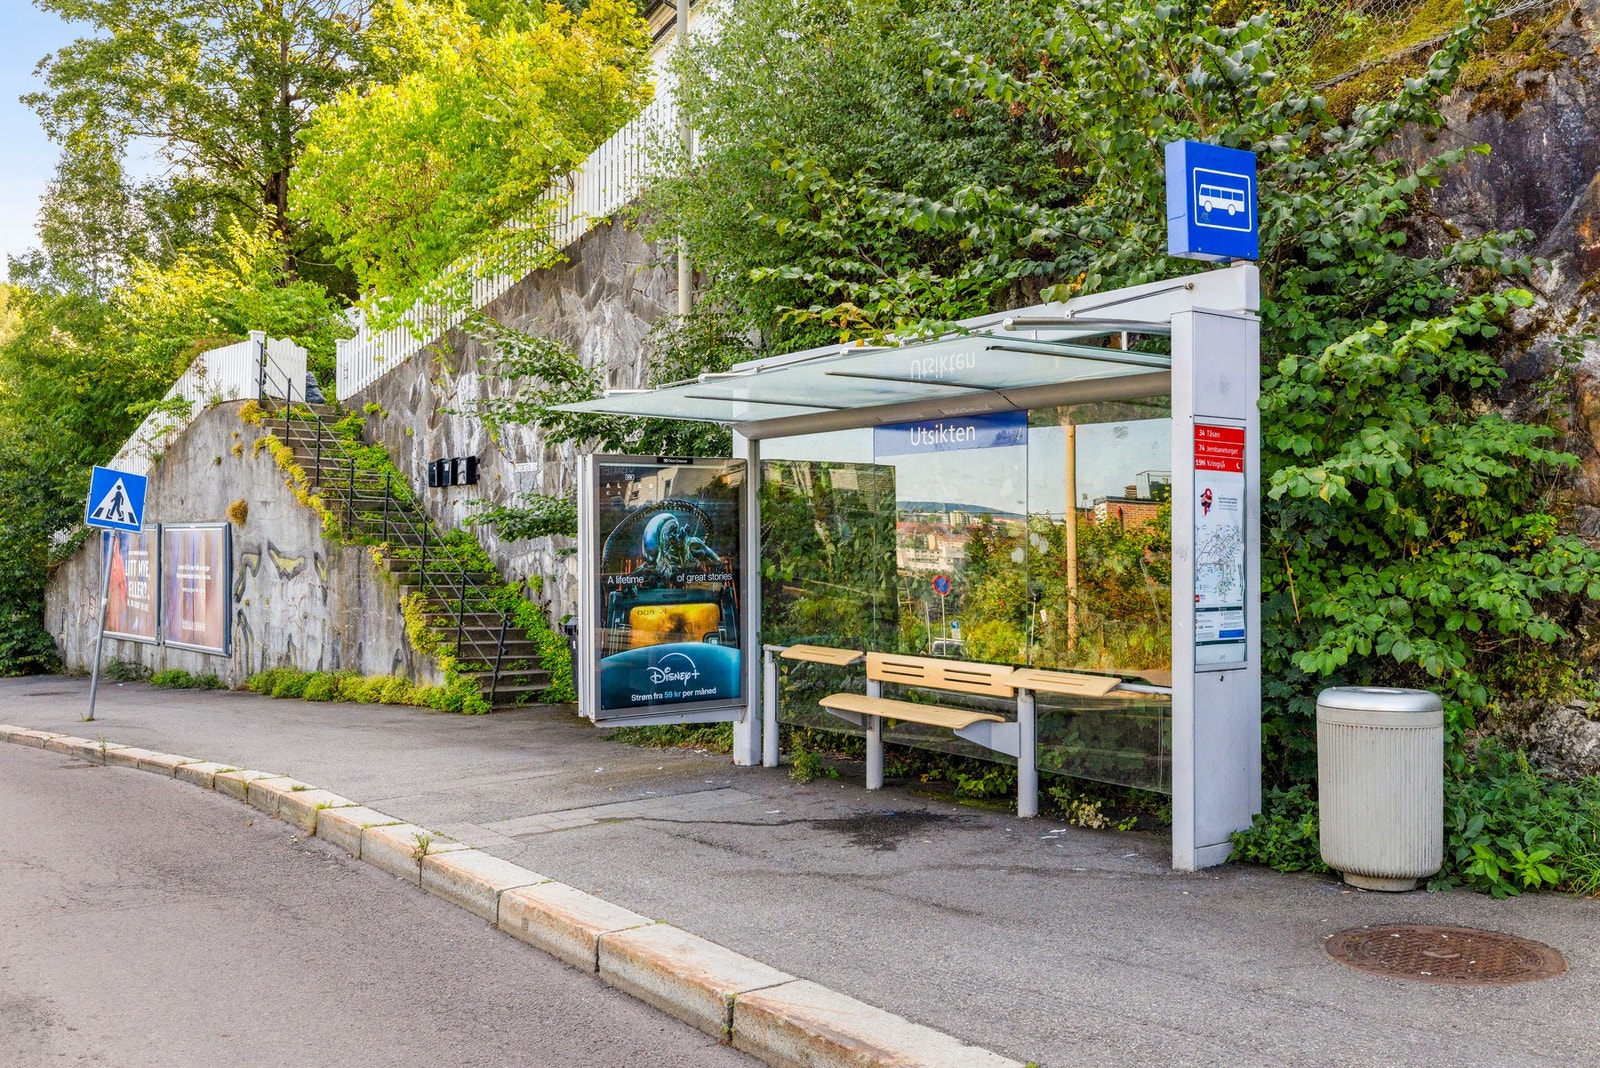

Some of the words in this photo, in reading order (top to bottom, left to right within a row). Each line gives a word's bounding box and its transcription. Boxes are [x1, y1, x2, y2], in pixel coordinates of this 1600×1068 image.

[910, 423, 976, 446] Utsikten
[607, 575, 614, 585] A
[615, 575, 645, 584] lifetime
[676, 573, 685, 583] of
[686, 573, 707, 584] great
[707, 571, 733, 581] stories
[631, 693, 653, 702] Strøm
[653, 691, 664, 700] fra
[664, 690, 673, 699] 59
[674, 690, 682, 698] kr
[682, 689, 693, 699] per
[694, 686, 717, 696] måned
